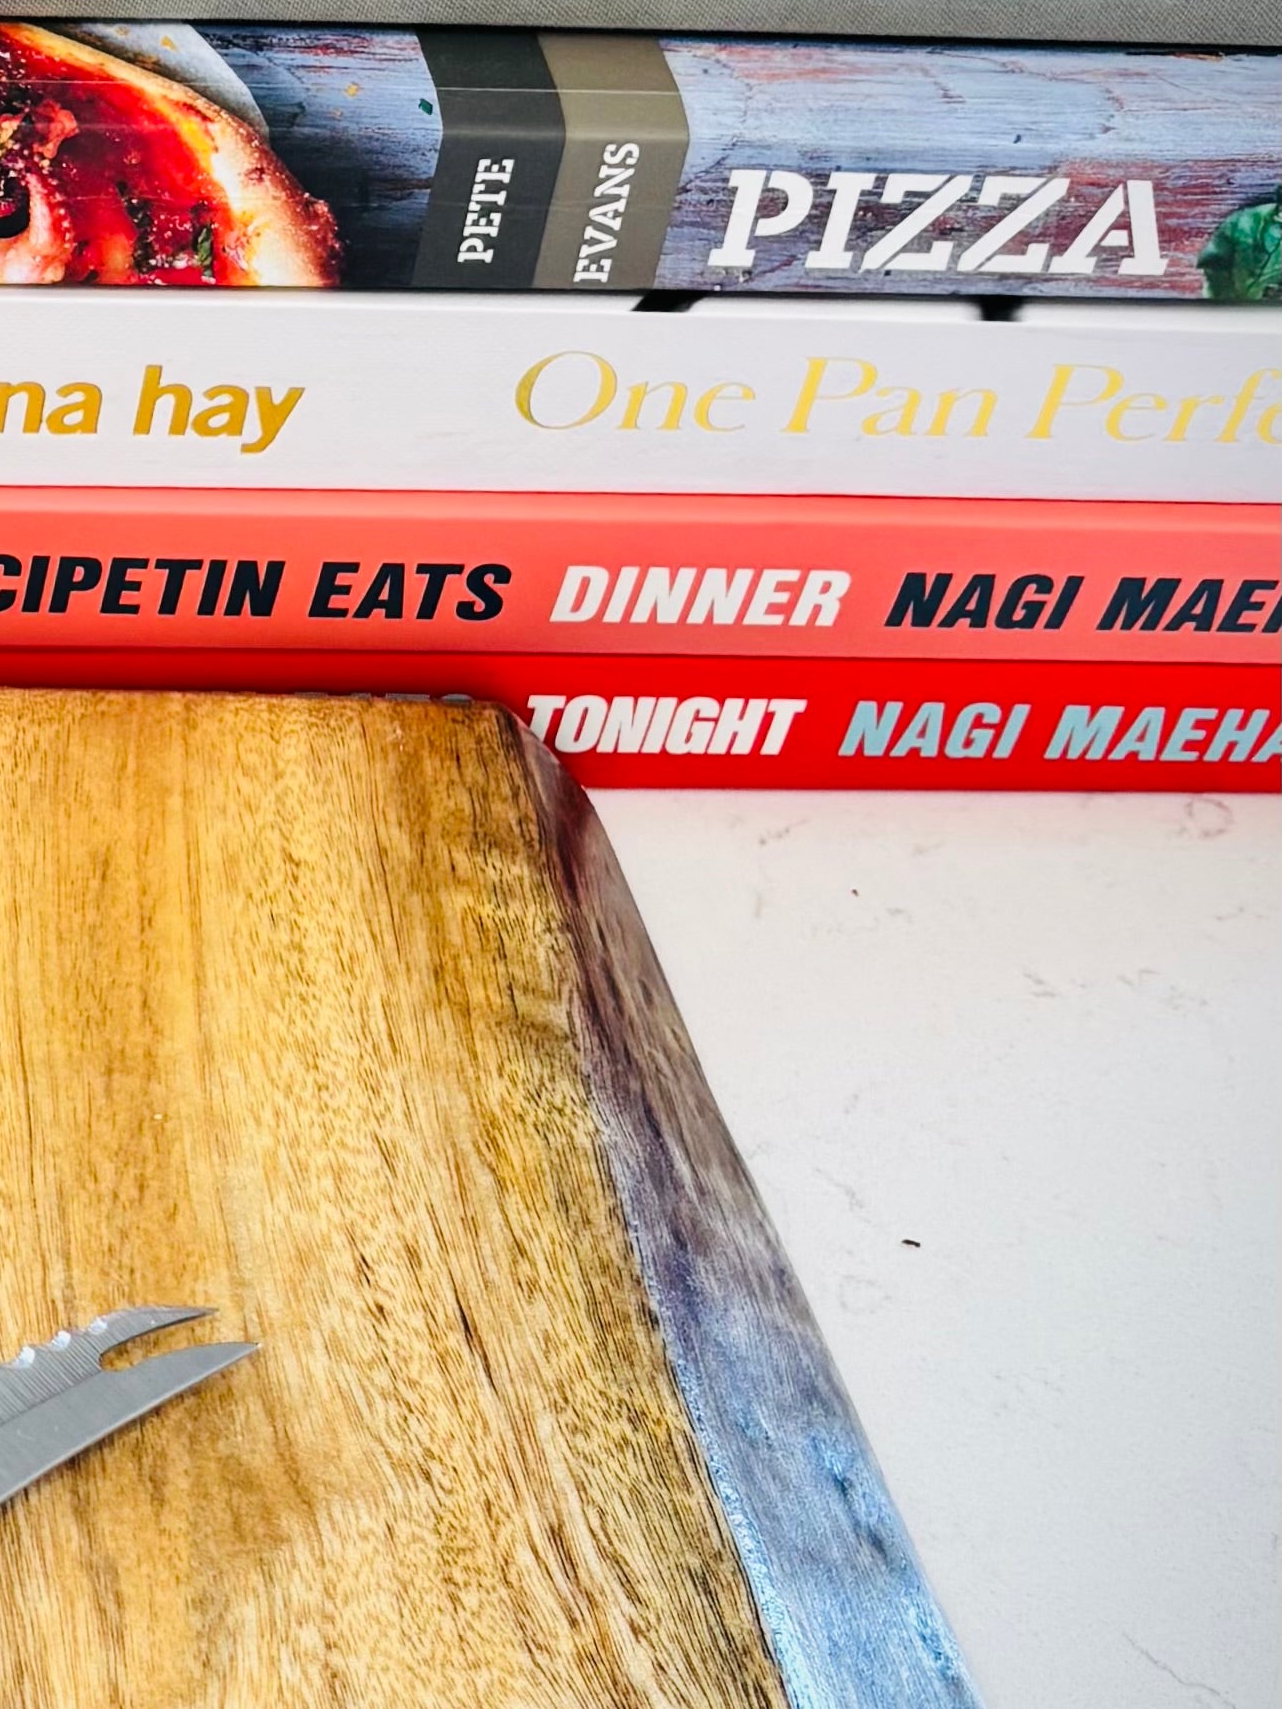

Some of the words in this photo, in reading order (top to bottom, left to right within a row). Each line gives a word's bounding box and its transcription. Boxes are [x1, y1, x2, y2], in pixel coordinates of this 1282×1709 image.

[457, 158, 515, 265] PETE
[572, 142, 640, 284] EVANS
[706, 169, 1169, 276] PIZZA
[133, 365, 306, 454] hay
[515, 350, 756, 431] One
[781, 357, 1009, 438] Pan
[307, 561, 512, 622] EATS
[550, 565, 851, 627] DINNER
[885, 572, 1085, 630] NAGI
[527, 694, 806, 756] TONIGHT
[838, 701, 1031, 758] NAGI
